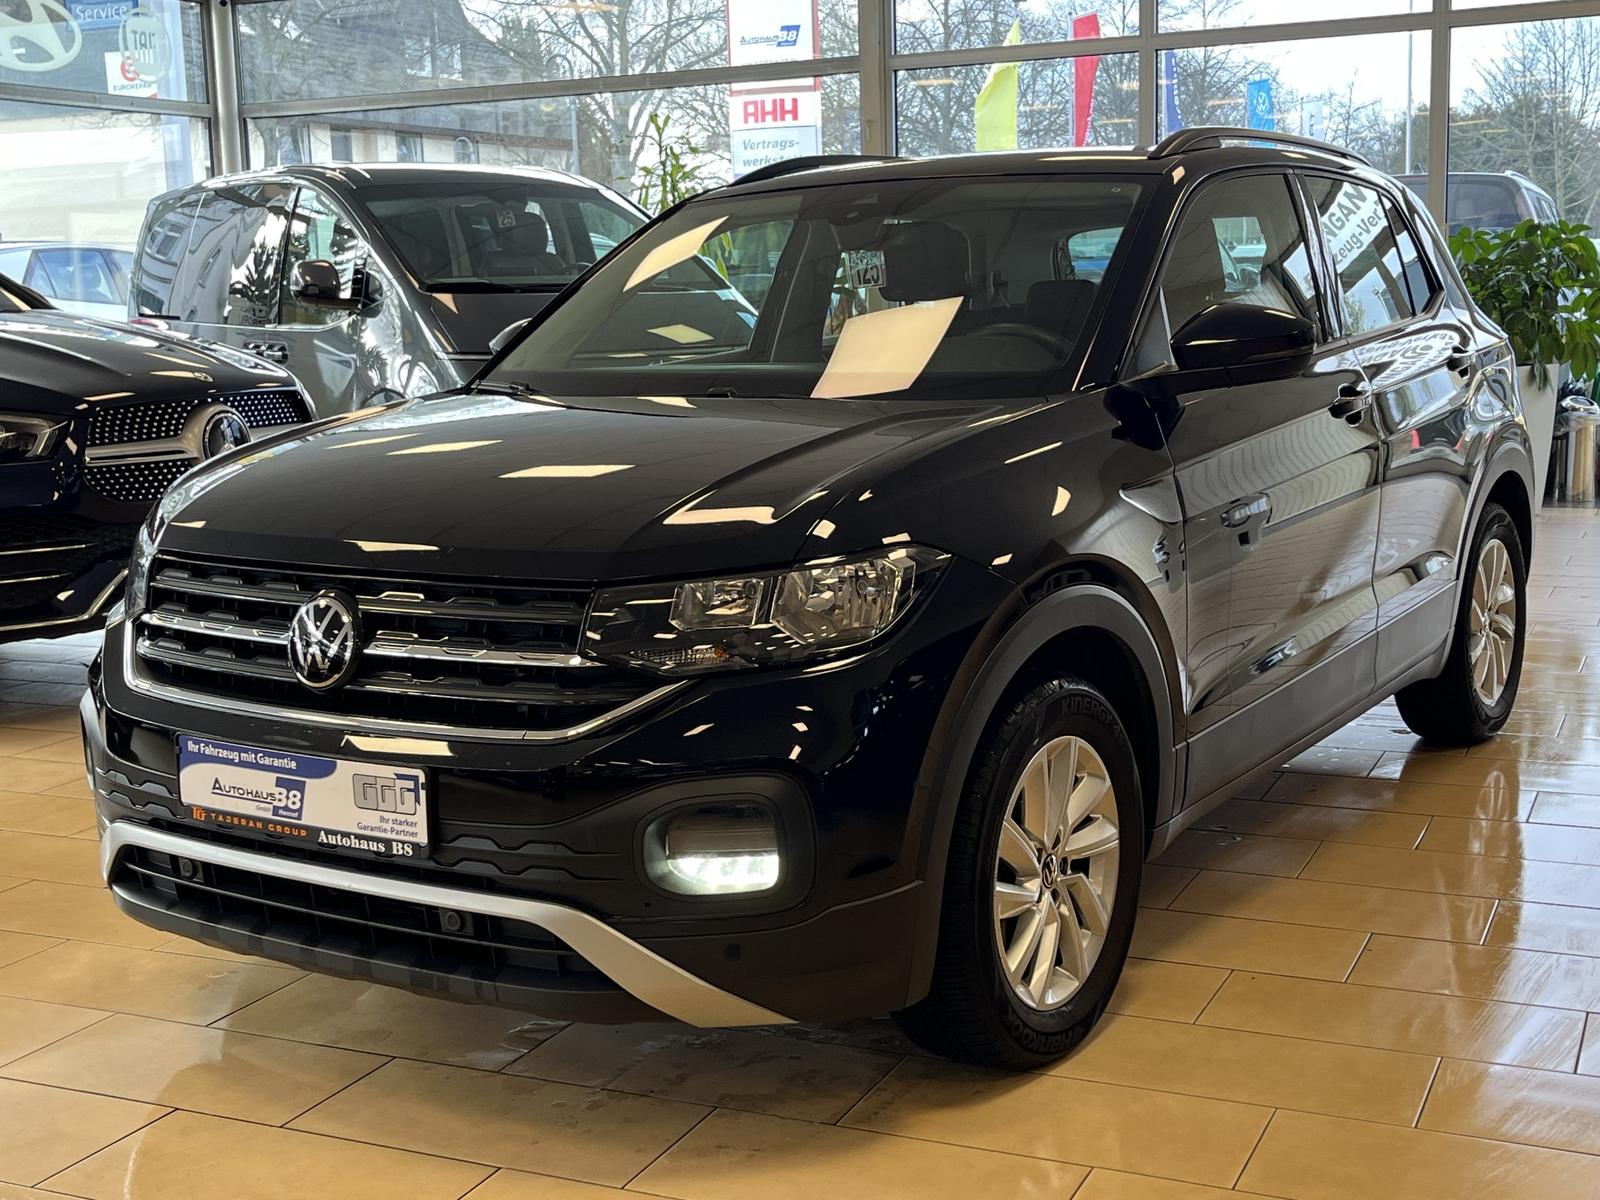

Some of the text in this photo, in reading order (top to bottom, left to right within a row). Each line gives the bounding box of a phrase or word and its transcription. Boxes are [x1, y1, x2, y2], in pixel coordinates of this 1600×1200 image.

[76, 3, 127, 21] Service
[743, 98, 798, 124] AHH
[743, 139, 800, 152] Vertrags-
[743, 154, 803, 167] werkst
[499, 212, 514, 226] 25
[187, 741, 297, 770] Ihr Fahrzeug mit Garantie
[275, 787, 302, 810] B8
[379, 815, 418, 828] Ihr starker
[268, 823, 308, 837] GROUP
[357, 822, 419, 838] Garantie-Partner
[317, 830, 414, 857] Autohaus B8
